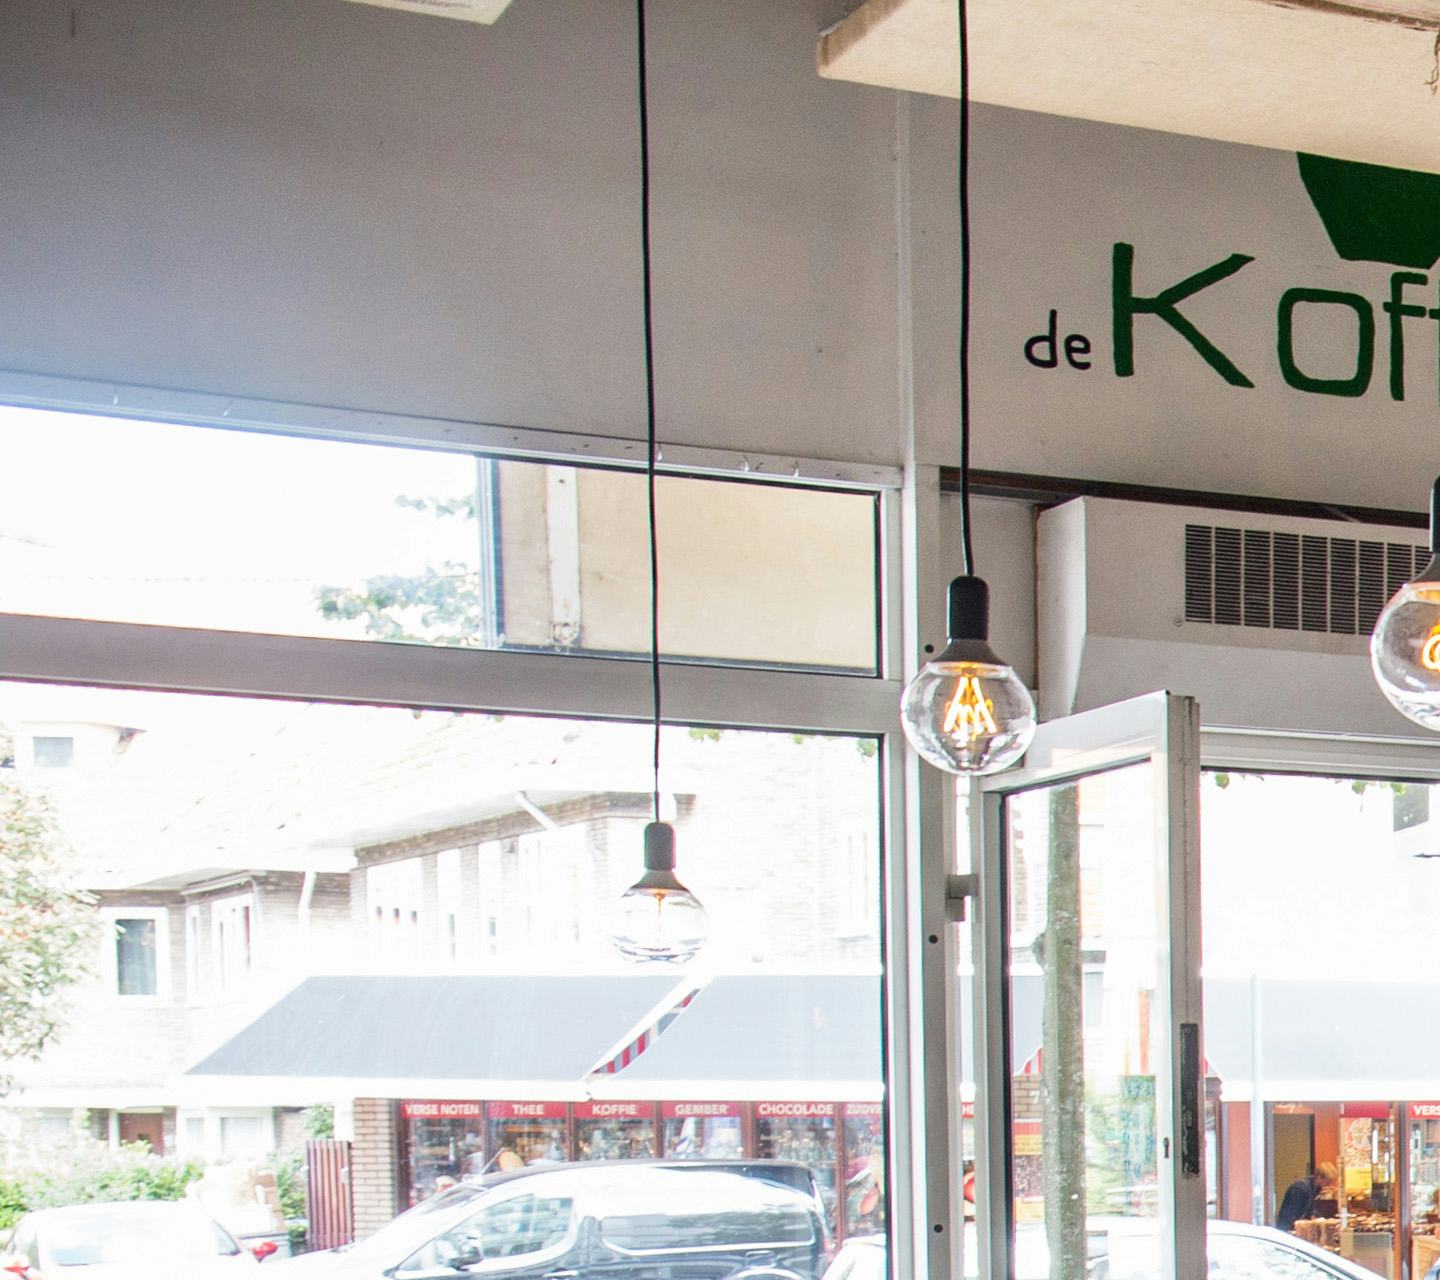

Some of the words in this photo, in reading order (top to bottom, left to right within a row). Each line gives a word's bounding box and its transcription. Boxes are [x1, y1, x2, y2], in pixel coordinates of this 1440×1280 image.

[1025, 311, 1092, 372] de
[405, 1104, 438, 1115] VERSE
[441, 1104, 480, 1115] NOTEN
[513, 1105, 546, 1115] THEE
[592, 1105, 637, 1115] KOFFIE
[675, 1105, 726, 1116] GEMBER
[759, 1104, 834, 1115] CHOCOLADE
